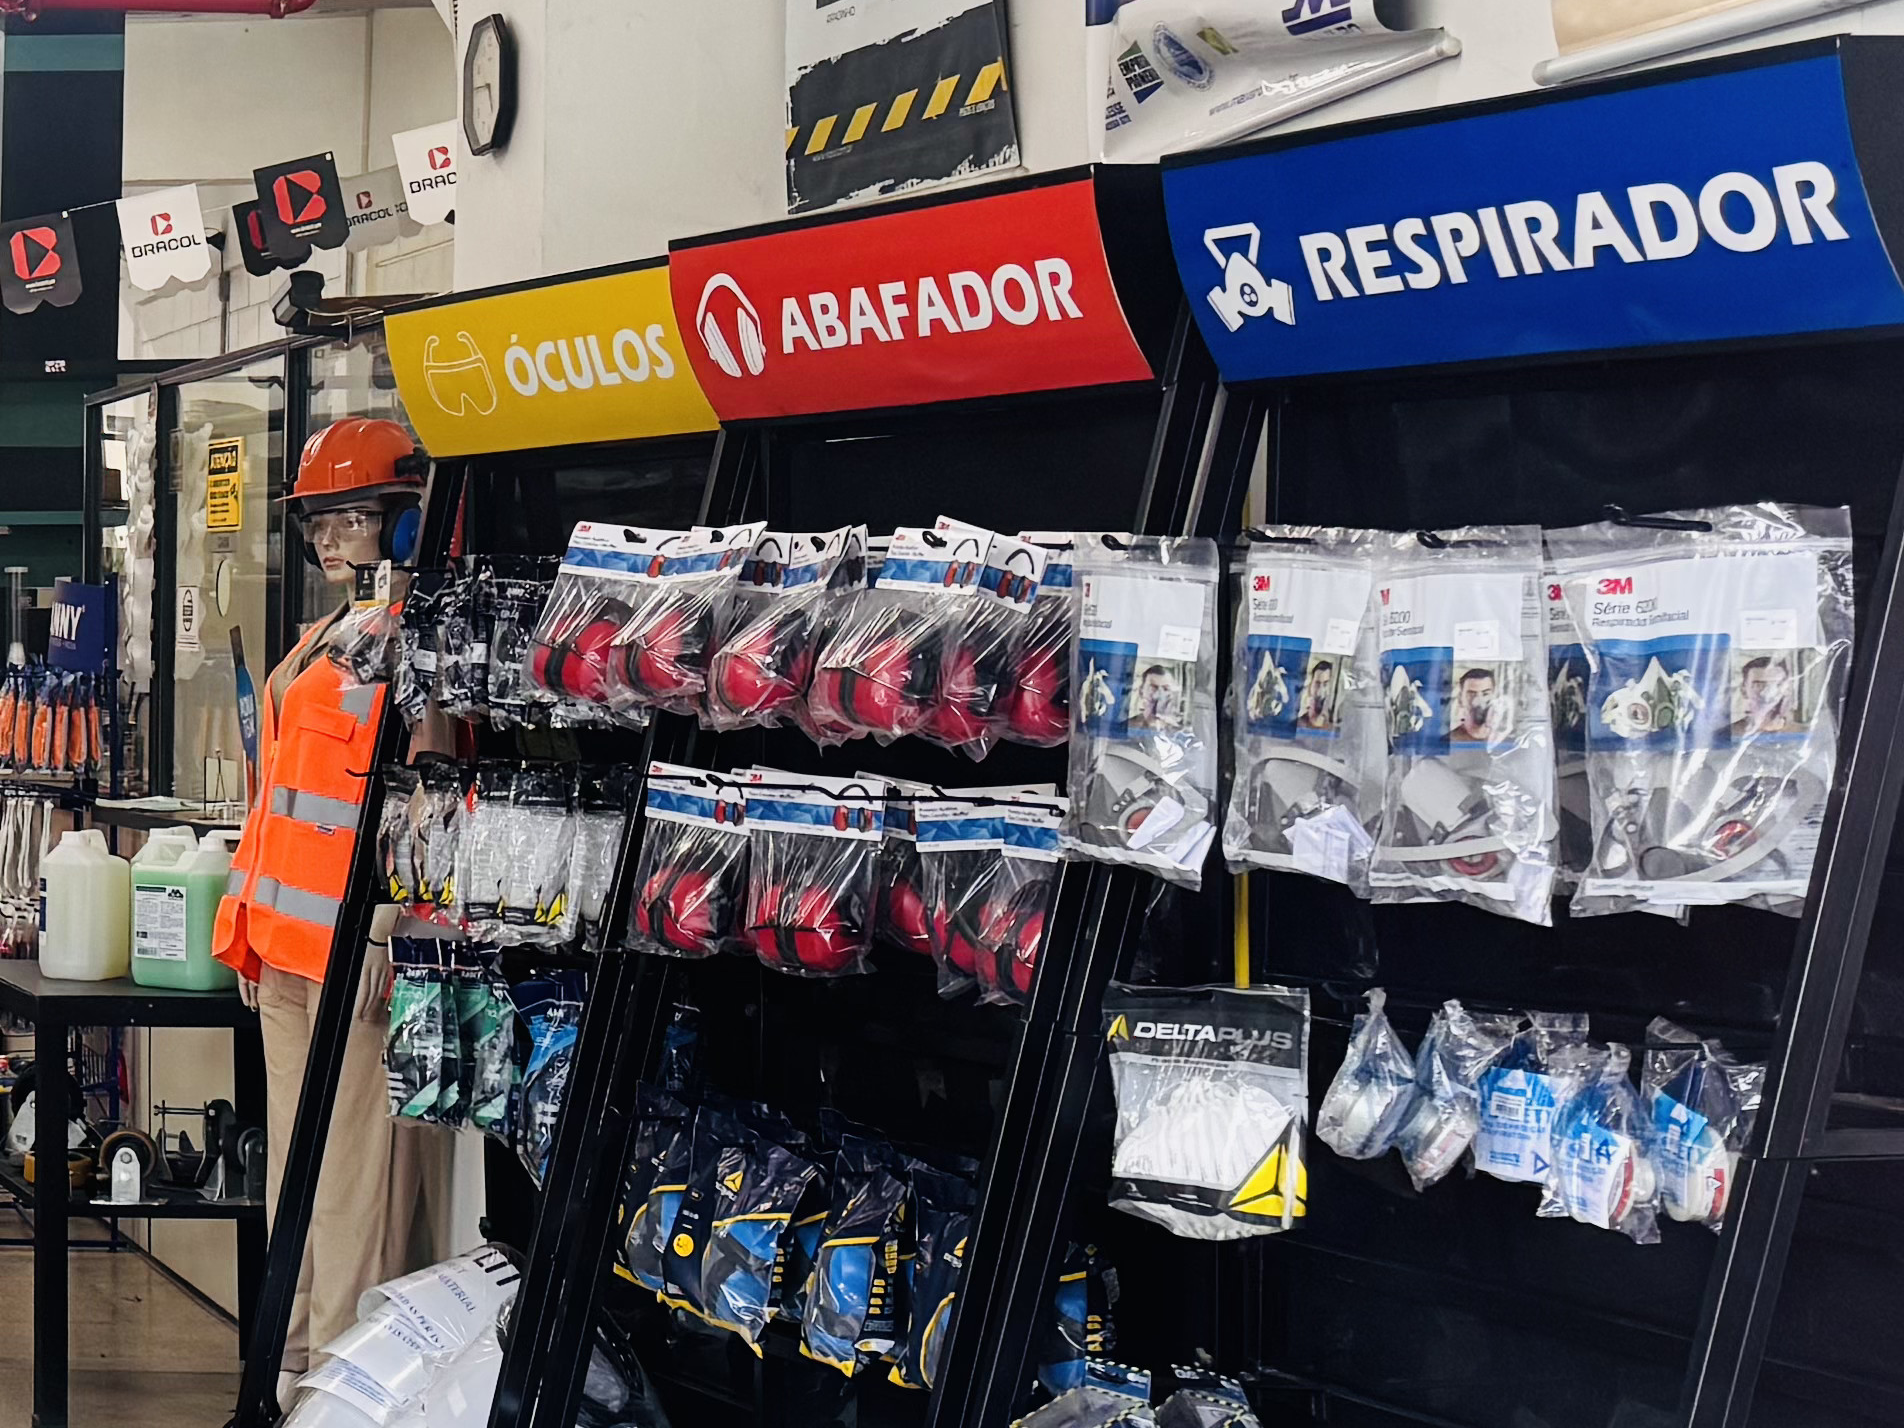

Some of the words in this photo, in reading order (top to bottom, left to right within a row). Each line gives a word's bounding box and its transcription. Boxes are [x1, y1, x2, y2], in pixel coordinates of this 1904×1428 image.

[409, 171, 457, 193] BRAC
[1298, 159, 1851, 302] RESPIRADOR
[131, 233, 202, 259] BRACOL
[780, 257, 1085, 355] ABAFADOR
[503, 322, 675, 398] ÓCULOS
[1253, 575, 1271, 592] 3M
[1596, 577, 1634, 596] 3M
[50, 602, 82, 641] NNY
[1593, 600, 1630, 617] Série
[1133, 1020, 1293, 1050] DELTAPLUS
